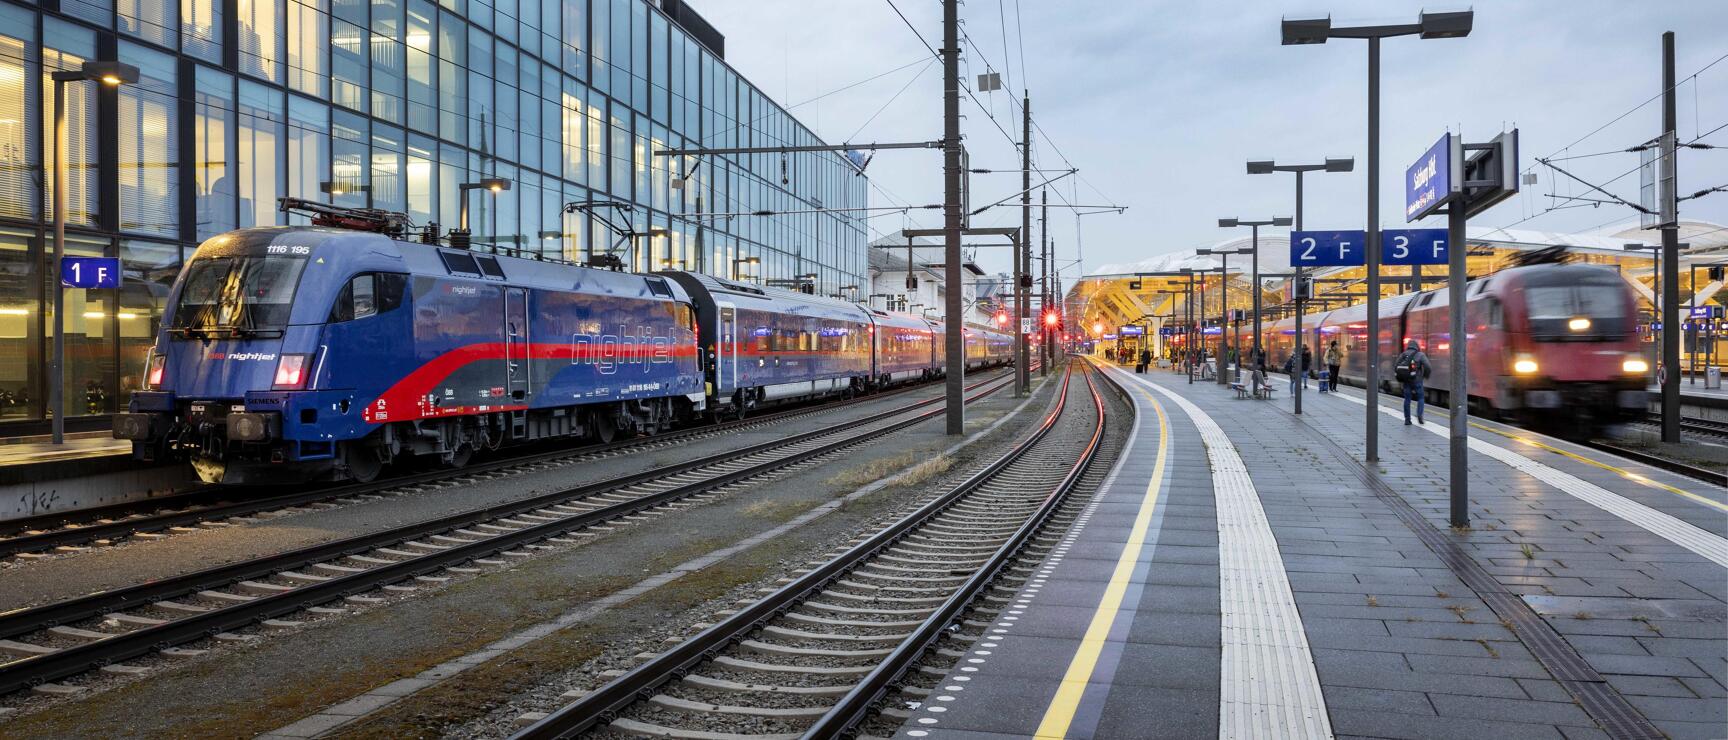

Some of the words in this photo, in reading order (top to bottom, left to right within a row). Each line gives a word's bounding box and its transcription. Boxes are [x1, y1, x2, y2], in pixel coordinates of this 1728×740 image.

[266, 245, 288, 253] 1116
[291, 245, 310, 255] 195
[1300, 237, 1317, 260] 2
[1339, 241, 1350, 260] F
[1392, 235, 1409, 259] 3
[1433, 240, 1445, 258] F
[71, 262, 81, 283] 1
[98, 267, 107, 283] F
[452, 285, 476, 295] nightjet
[228, 352, 277, 361] nightjet
[571, 325, 676, 374] nightjet
